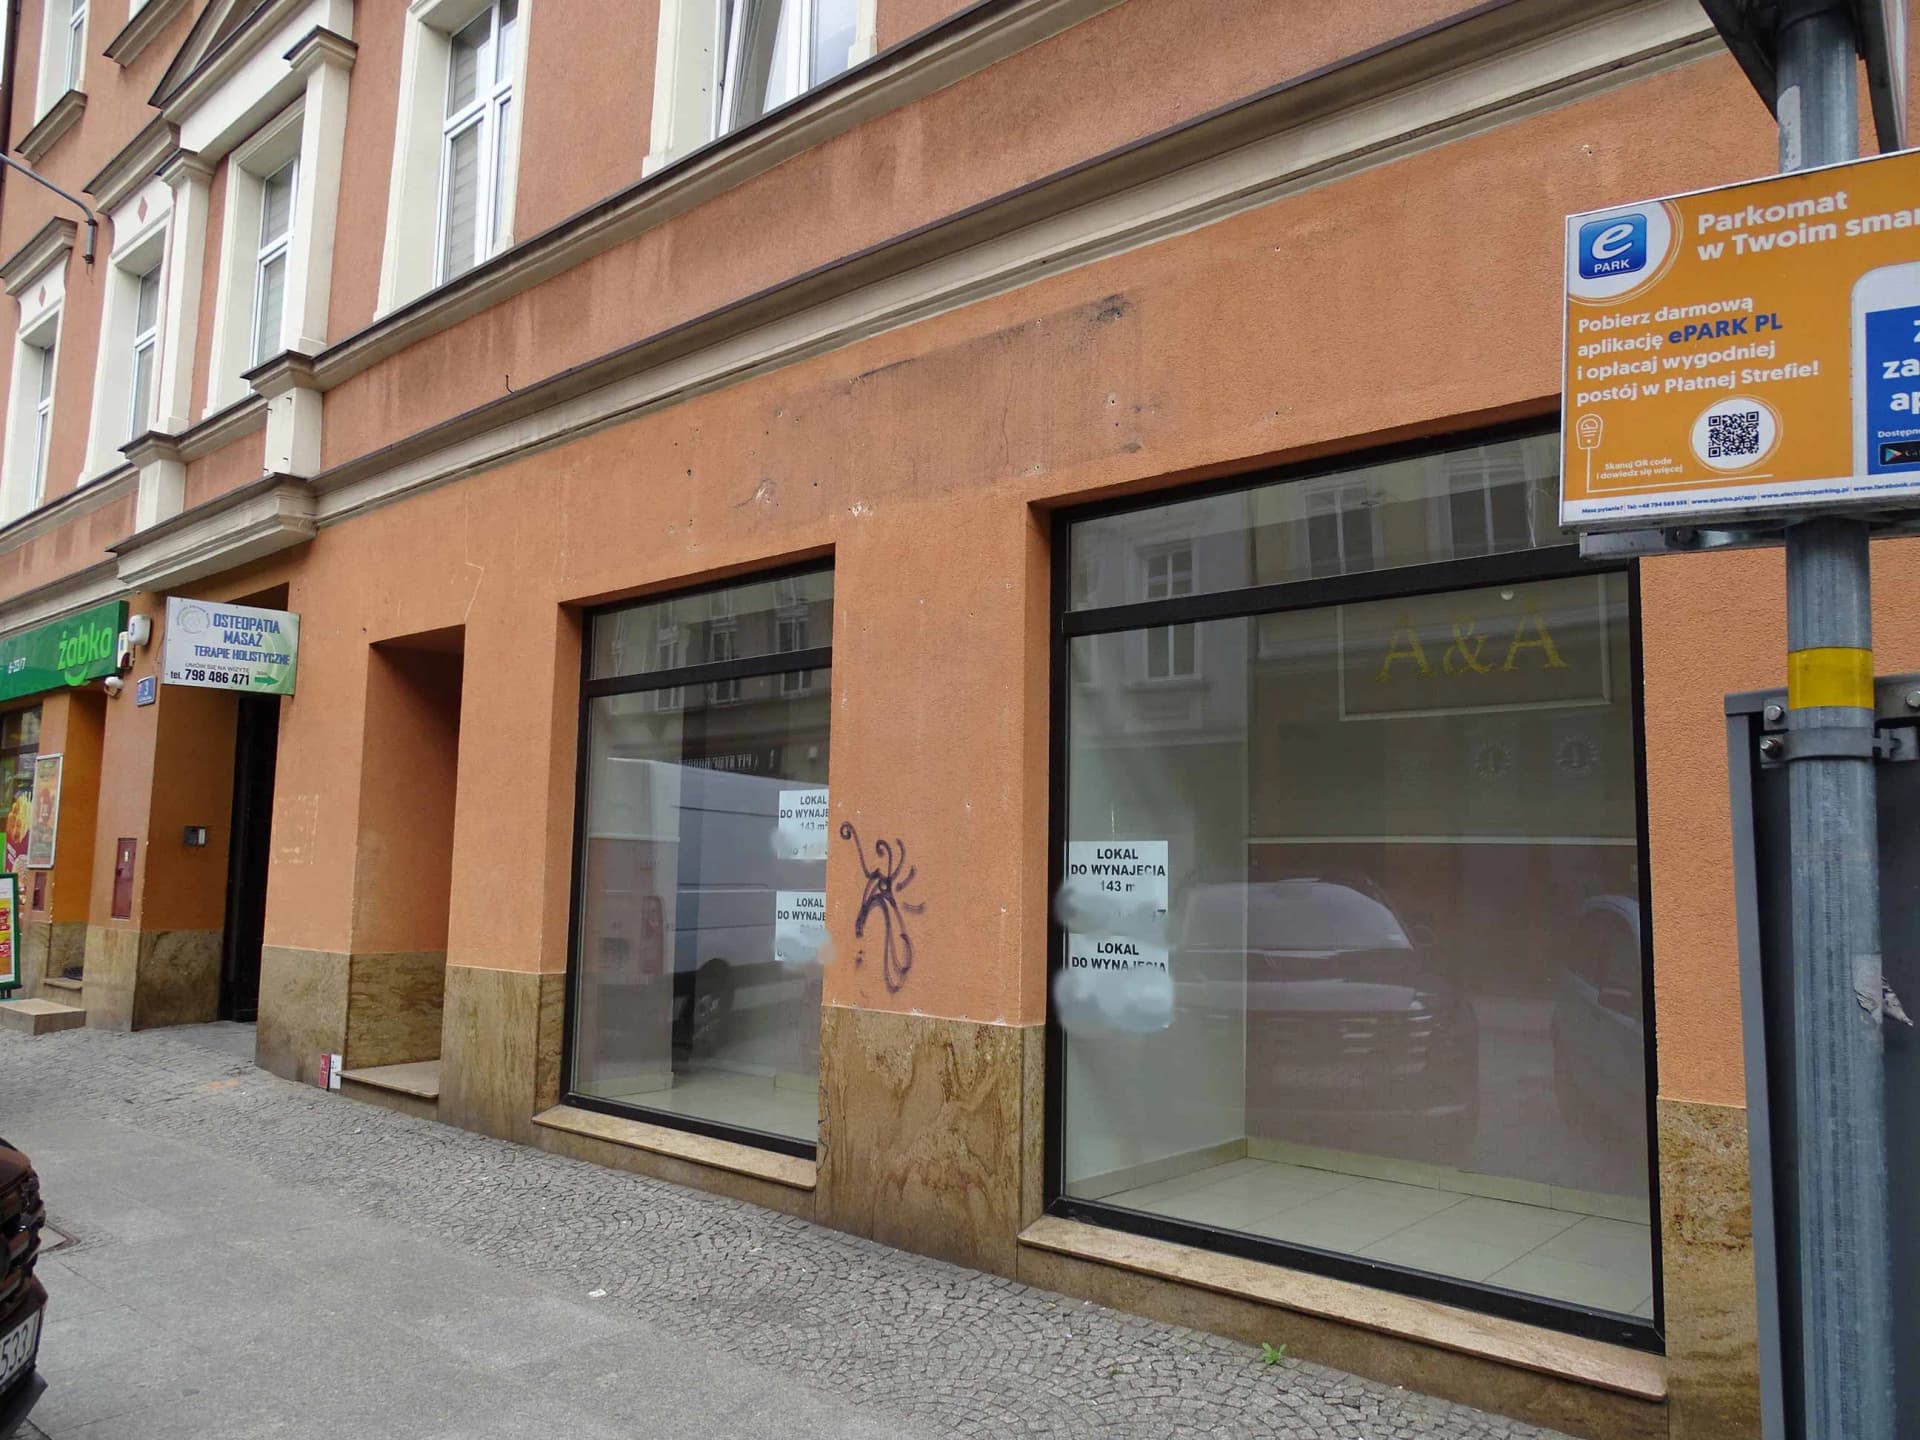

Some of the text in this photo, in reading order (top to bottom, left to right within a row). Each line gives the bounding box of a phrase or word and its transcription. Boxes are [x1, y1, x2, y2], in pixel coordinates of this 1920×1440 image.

[1697, 191, 1848, 235] Parkomat
[1697, 242, 1724, 261] w
[1732, 223, 1837, 256] Twoim
[1594, 258, 1630, 273] PARK
[1577, 296, 1753, 333] Pobierz darmową
[1577, 313, 1783, 358] aplikację ePARK PL
[1577, 340, 1777, 380] i opłacaj wygodniej
[1576, 360, 1820, 407] postój w Płatnej Strefie!
[1650, 456, 1673, 466] code
[213, 613, 281, 634] OSTEOPATIA
[57, 622, 112, 671] żabka
[223, 630, 264, 648] MASAŻ
[194, 645, 290, 666] TERAPIE HOLISTYCZNE
[170, 668, 250, 686] tel. 798 486 471
[800, 796, 827, 805] LOKAL
[780, 809, 793, 818] DO
[1097, 848, 1139, 860] LOKAL
[1071, 864, 1088, 875] DO
[797, 898, 825, 908] LOKAL
[777, 910, 790, 920] DO
[1097, 943, 1140, 956] LOKAL
[1071, 957, 1088, 969] DO
